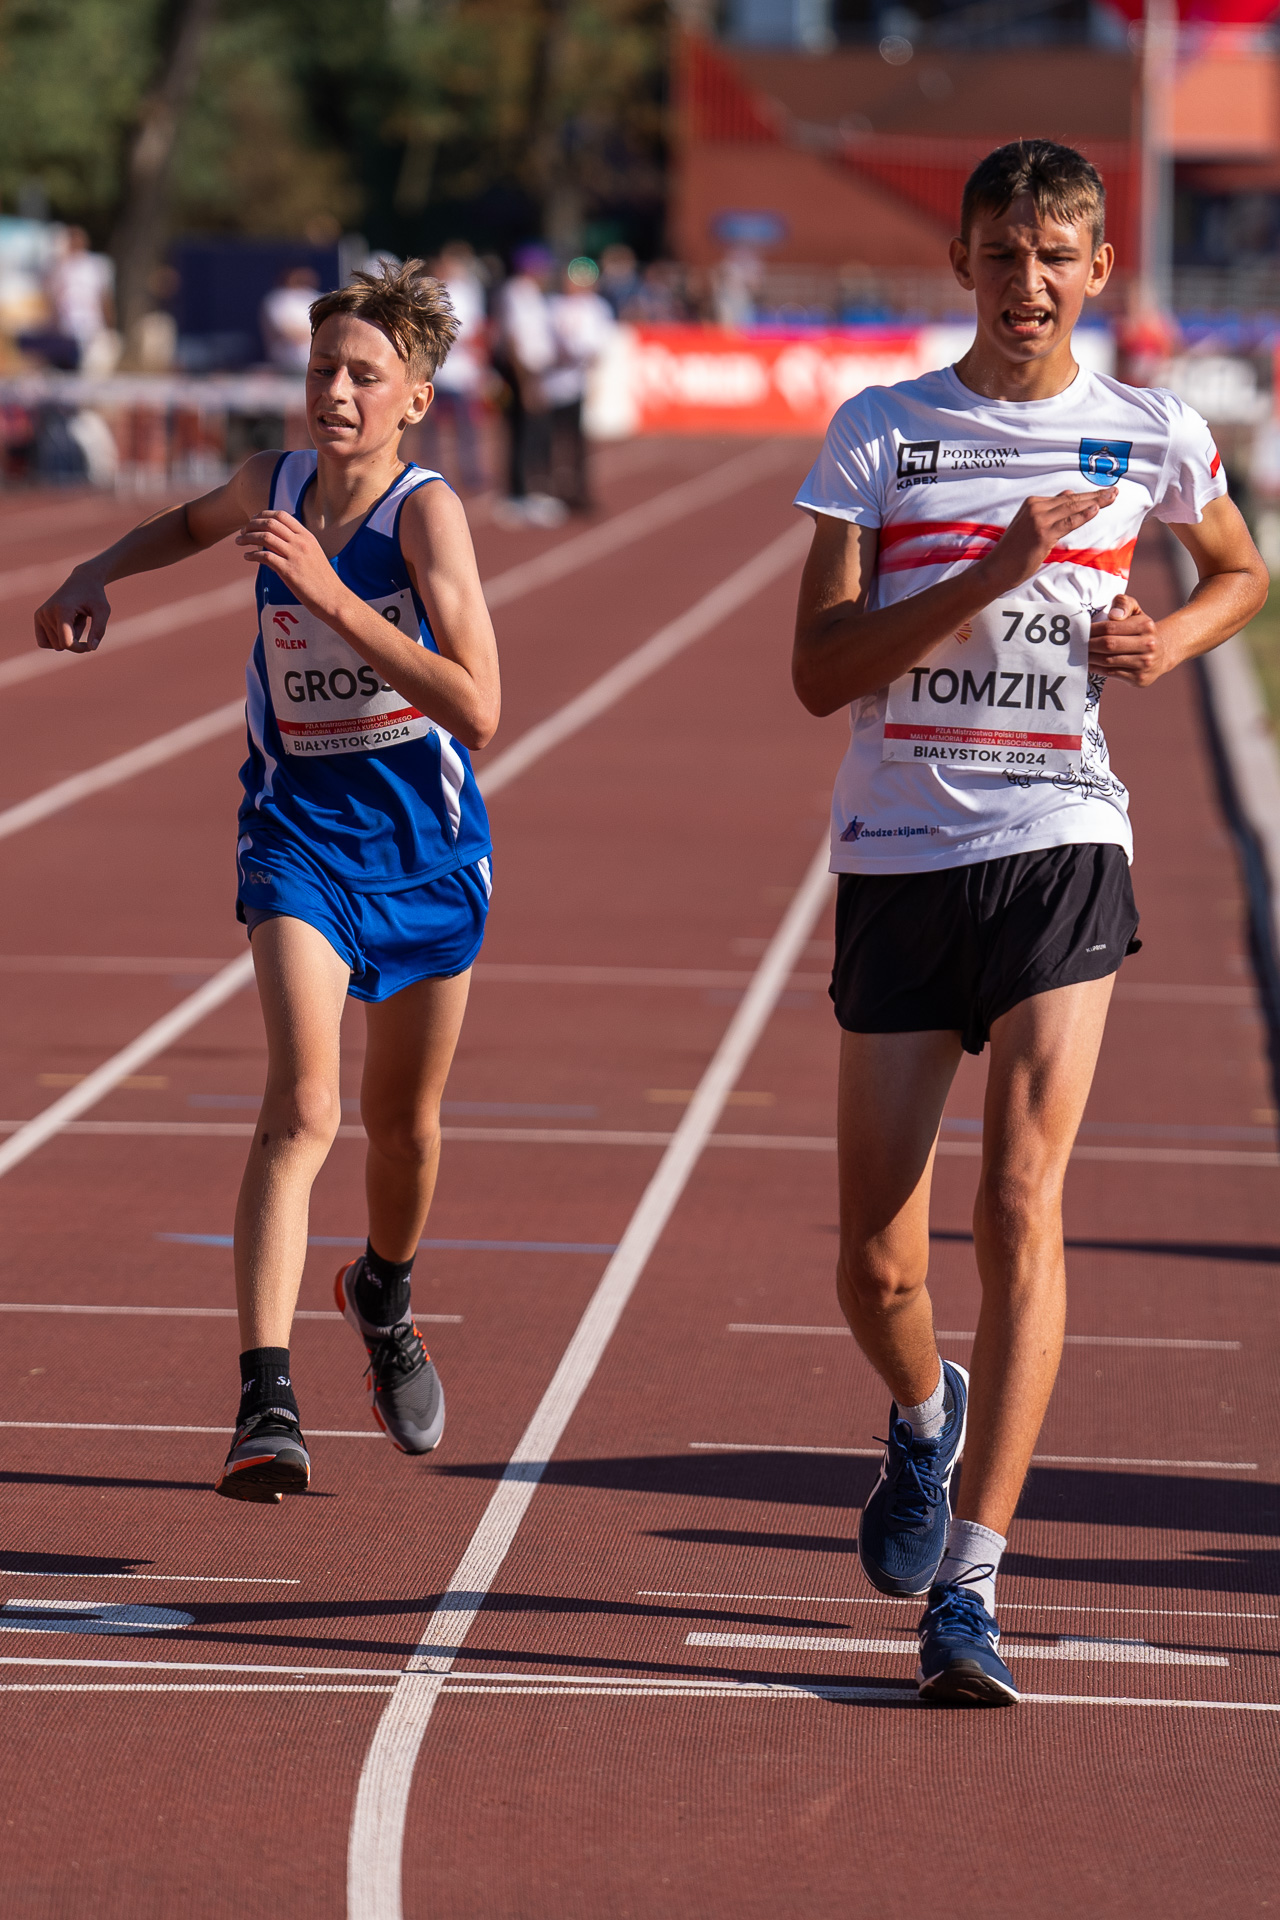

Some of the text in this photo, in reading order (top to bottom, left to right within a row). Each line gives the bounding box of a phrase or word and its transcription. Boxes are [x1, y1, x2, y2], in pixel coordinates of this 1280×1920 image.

[942, 448, 1021, 459] PODKOWA
[896, 475, 938, 490] KABEX
[1002, 610, 1071, 646] 768
[274, 638, 307, 650] ORLEN
[284, 665, 395, 703] GROS
[907, 667, 1067, 712] TOMZIK
[294, 726, 410, 751] BIAŁYSTOK 2024
[952, 729, 993, 737] Mistrzostwa
[964, 736, 996, 745] JANUSZA
[914, 746, 1046, 766] BIAŁYSTOK 2024
